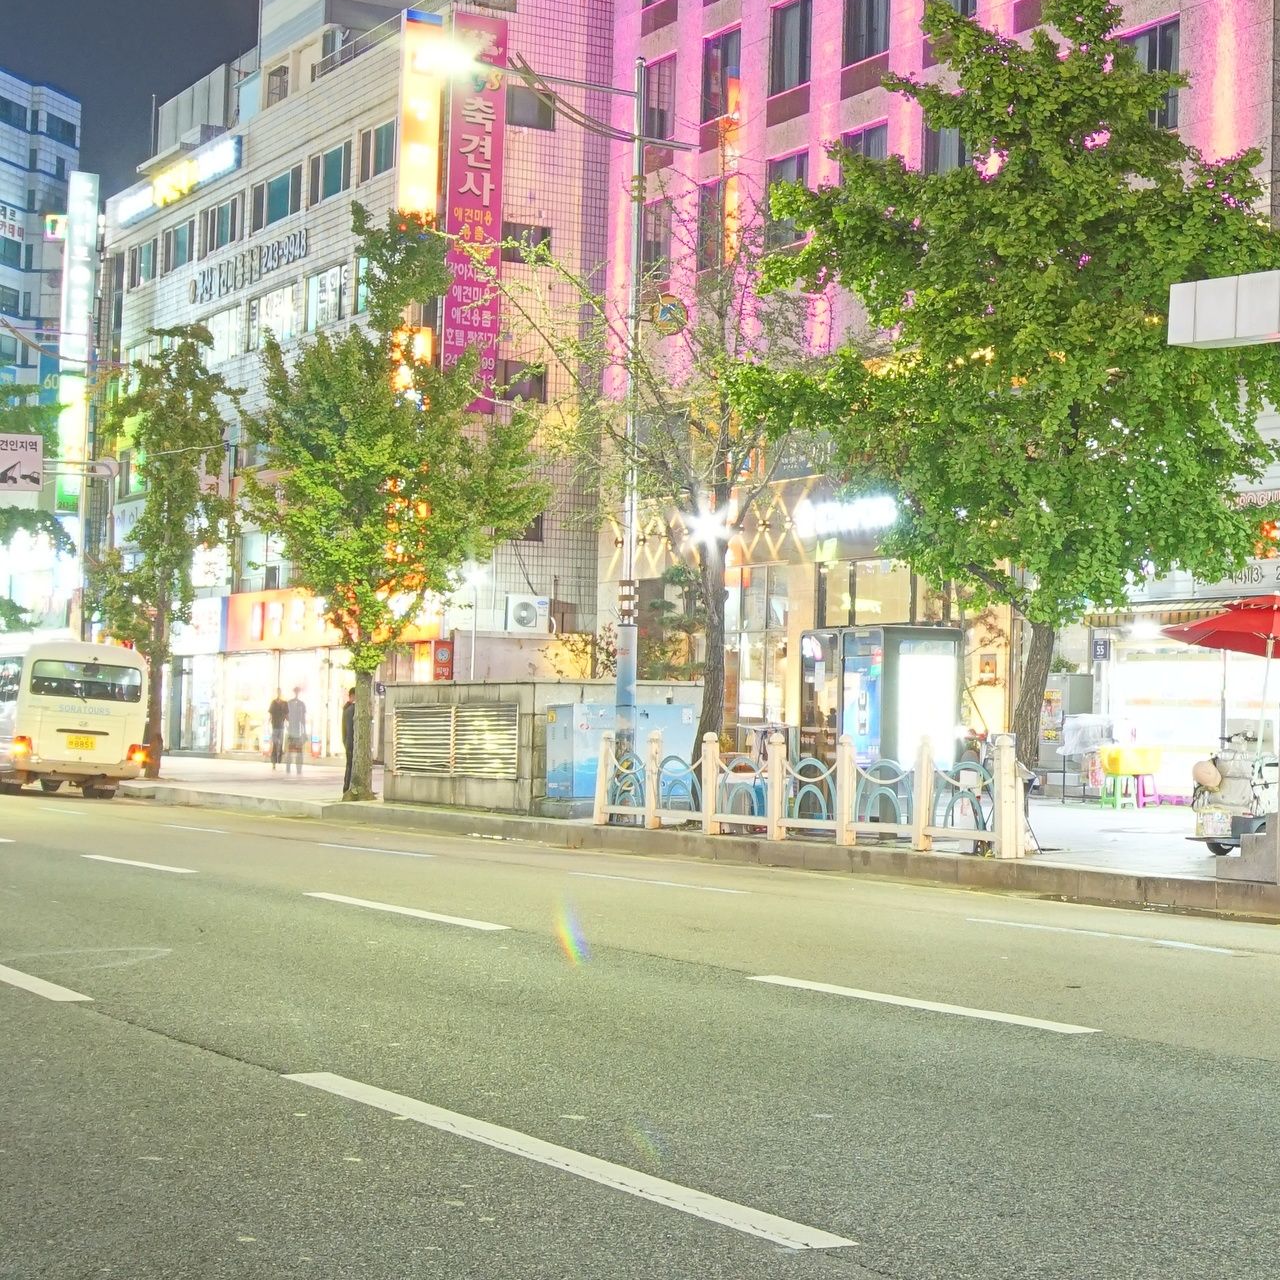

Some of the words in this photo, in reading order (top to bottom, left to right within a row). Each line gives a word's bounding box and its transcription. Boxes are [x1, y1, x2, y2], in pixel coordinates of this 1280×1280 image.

[457, 96, 497, 207] 축견사
[453, 207, 493, 226] 애견미용
[262, 228, 308, 275] 243-9948
[1096, 645, 1105, 656] 55
[58, 703, 112, 715] SORATOURS
